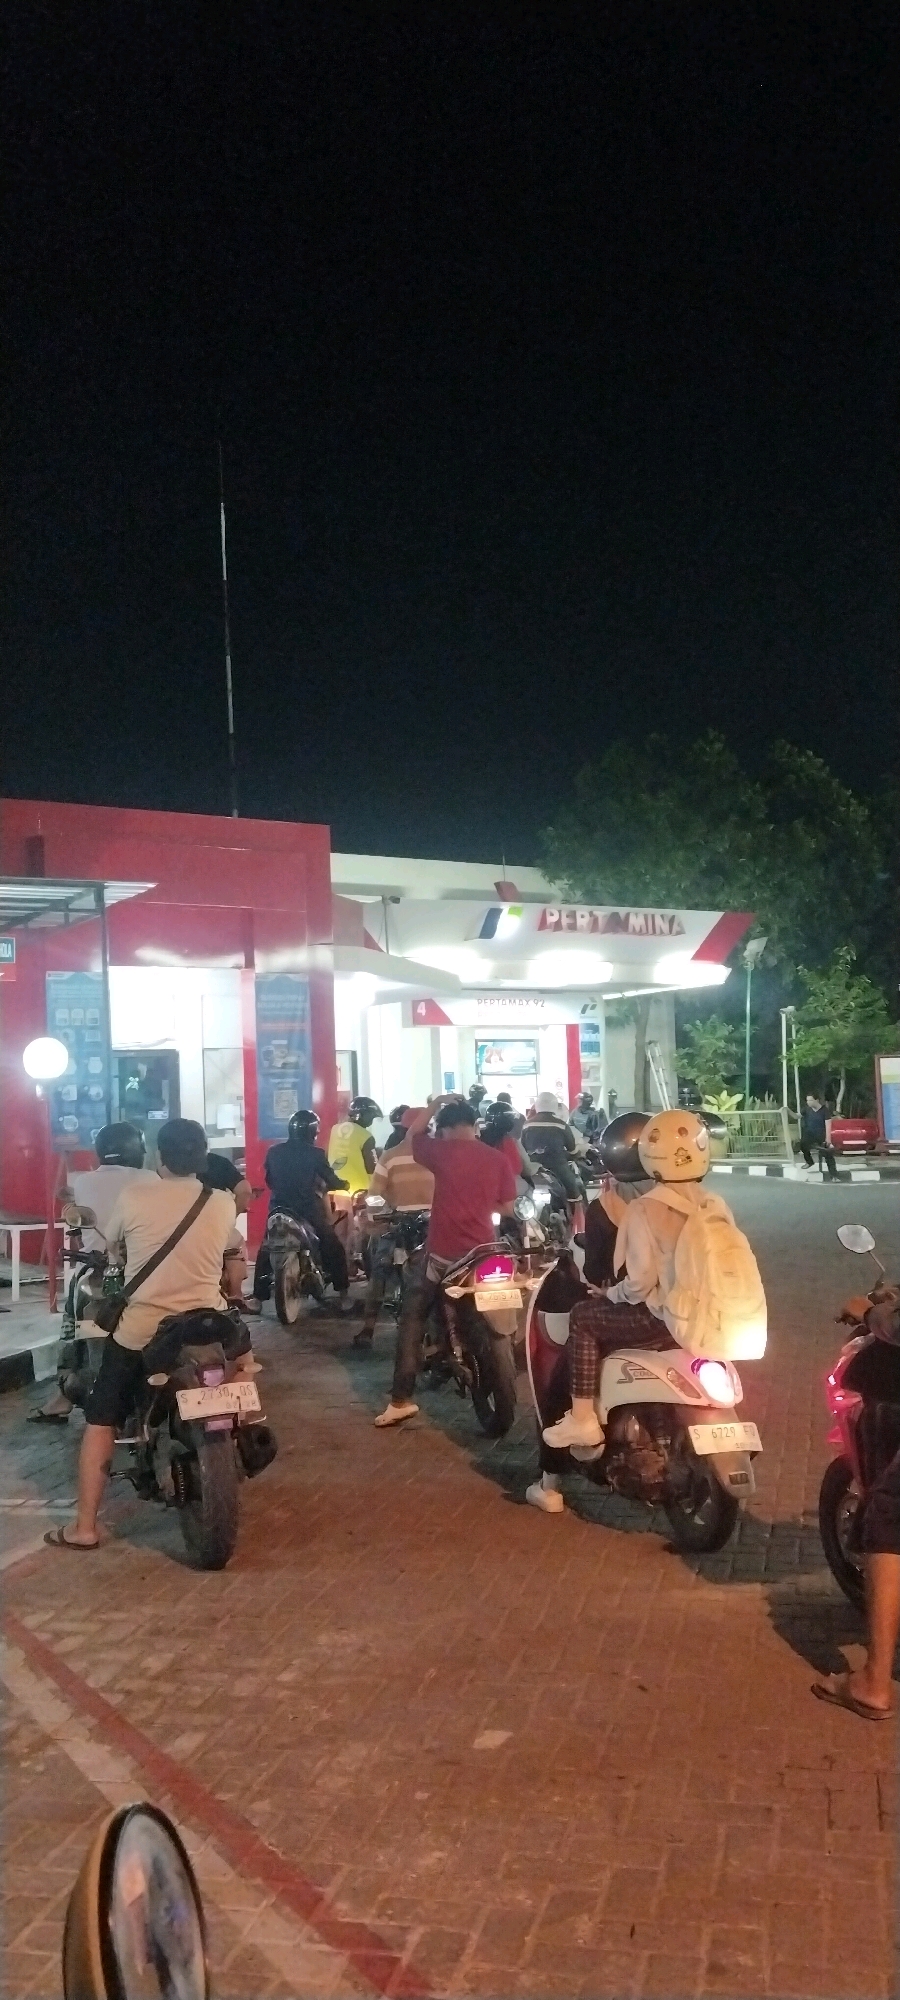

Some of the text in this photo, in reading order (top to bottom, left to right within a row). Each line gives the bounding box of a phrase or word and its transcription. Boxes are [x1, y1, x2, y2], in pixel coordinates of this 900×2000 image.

[537, 908, 686, 936] PERTAMINA
[416, 1001, 427, 1016] 4
[477, 998, 545, 1007] PERTAMAX 92
[181, 1393, 189, 1404] S
[200, 1386, 230, 1401] 2730
[693, 1428, 701, 1440] S
[711, 1426, 736, 1438] 6729
